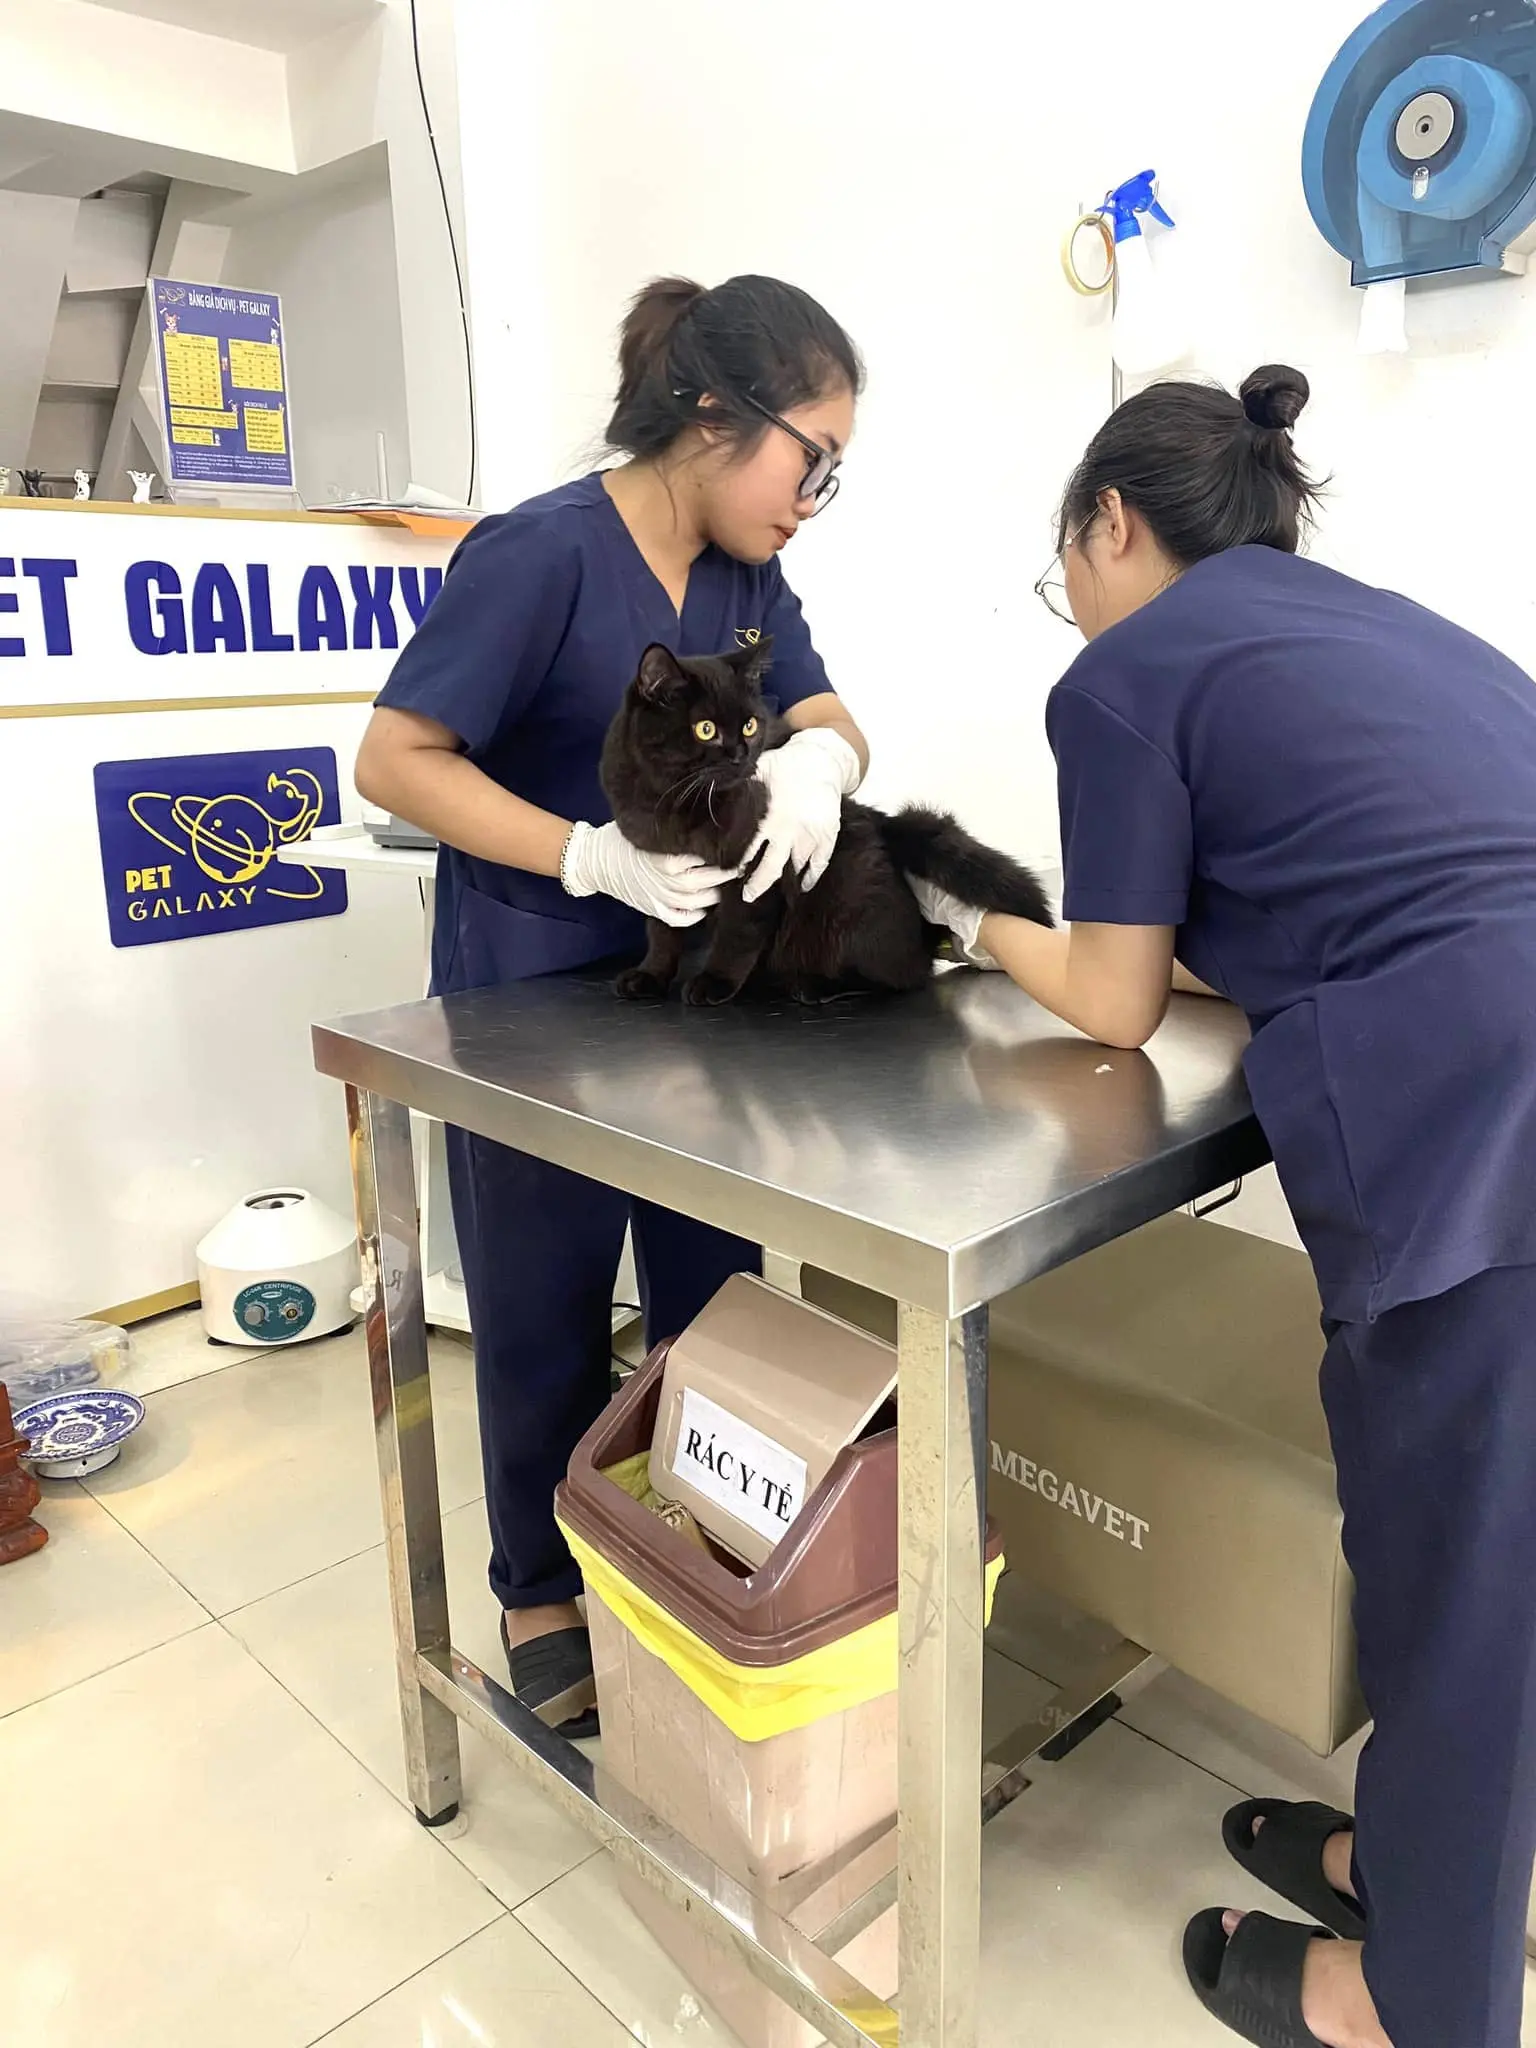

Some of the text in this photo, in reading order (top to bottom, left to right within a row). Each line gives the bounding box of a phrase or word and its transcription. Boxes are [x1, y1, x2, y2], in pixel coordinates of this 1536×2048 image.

[239, 300, 249, 313] PET
[249, 301, 271, 316] GALAXY
[125, 560, 443, 655] GALAXY
[125, 864, 172, 893] PET
[128, 885, 256, 921] GALAXY
[684, 1427, 793, 1523] RÁC Y TẾ
[990, 1440, 1150, 1550] MEGAVET
